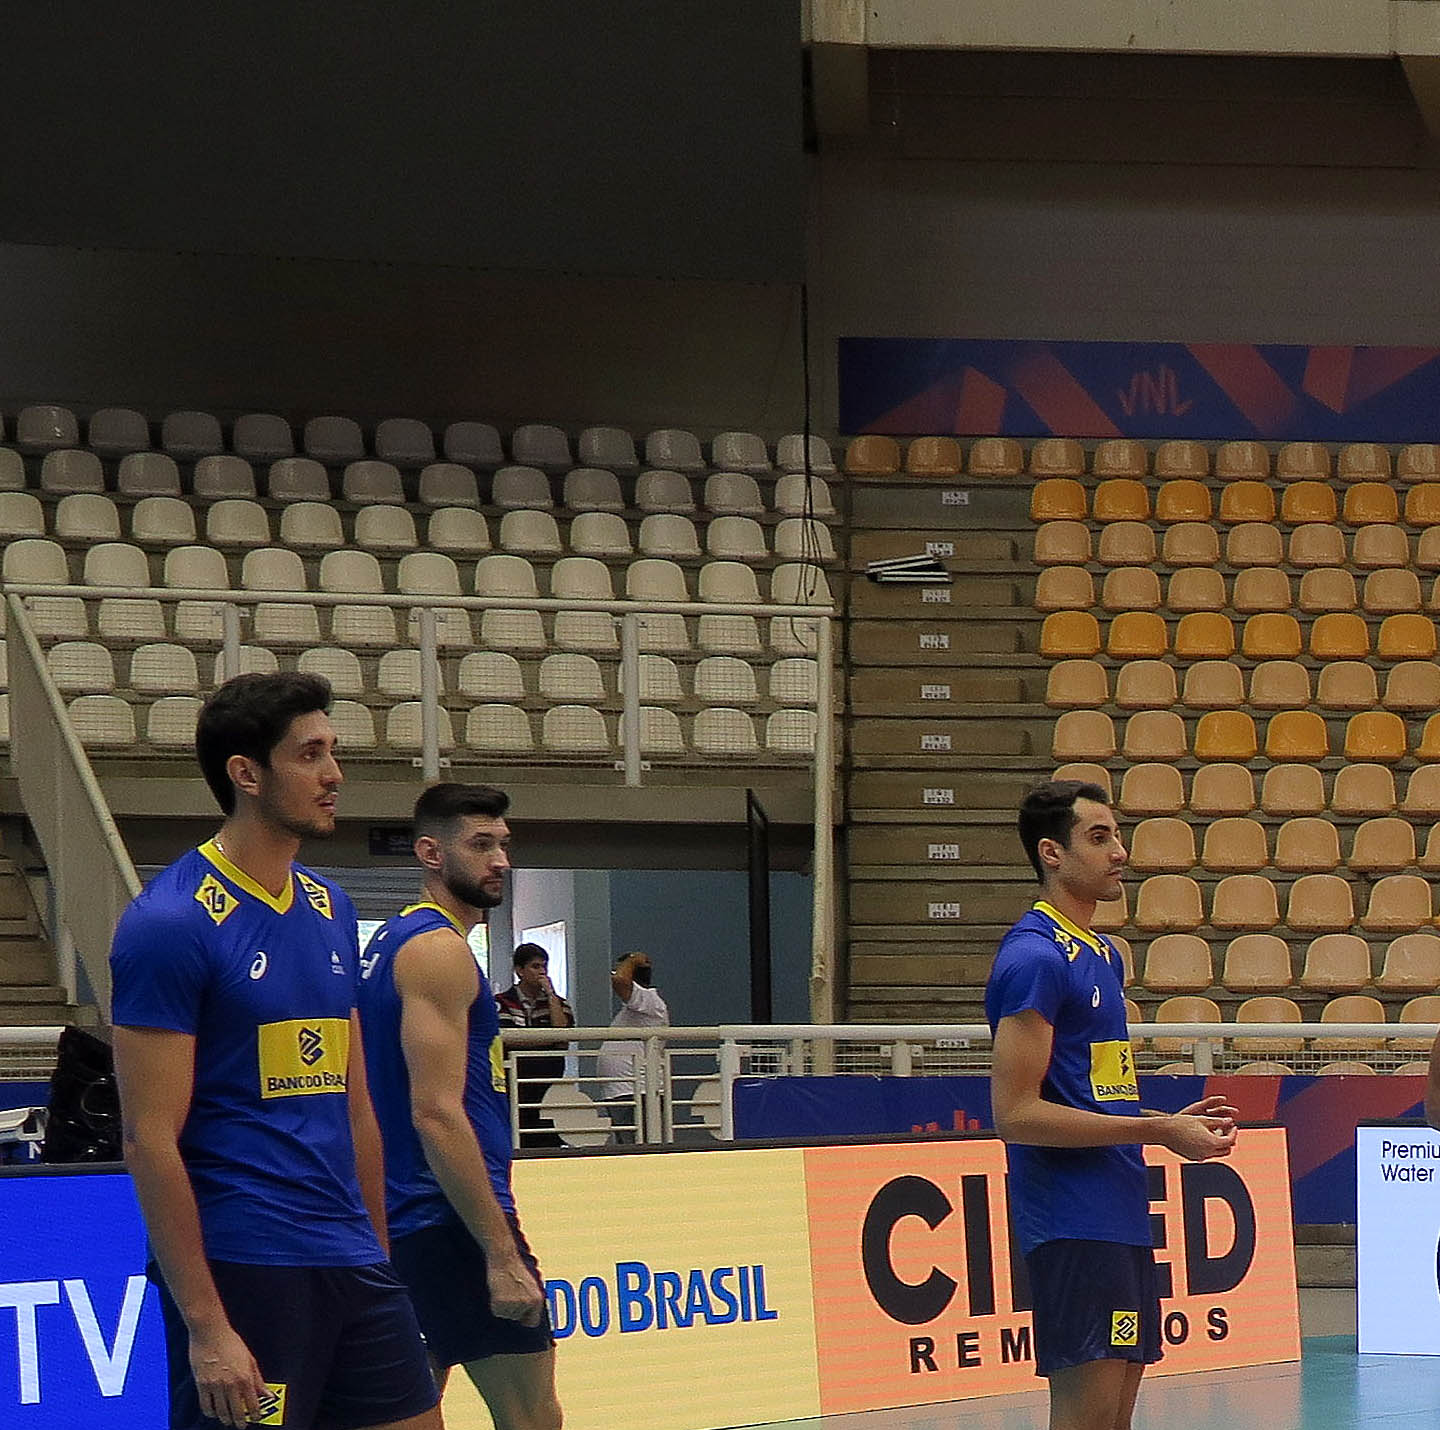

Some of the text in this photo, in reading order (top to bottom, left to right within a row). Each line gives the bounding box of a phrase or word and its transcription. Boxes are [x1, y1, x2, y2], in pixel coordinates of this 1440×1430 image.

[1381, 1163, 1435, 1182] Water
[552, 1261, 779, 1340] DO BRASIL
[0, 1275, 147, 1405] TV
[909, 1307, 1230, 1375] REMOS
